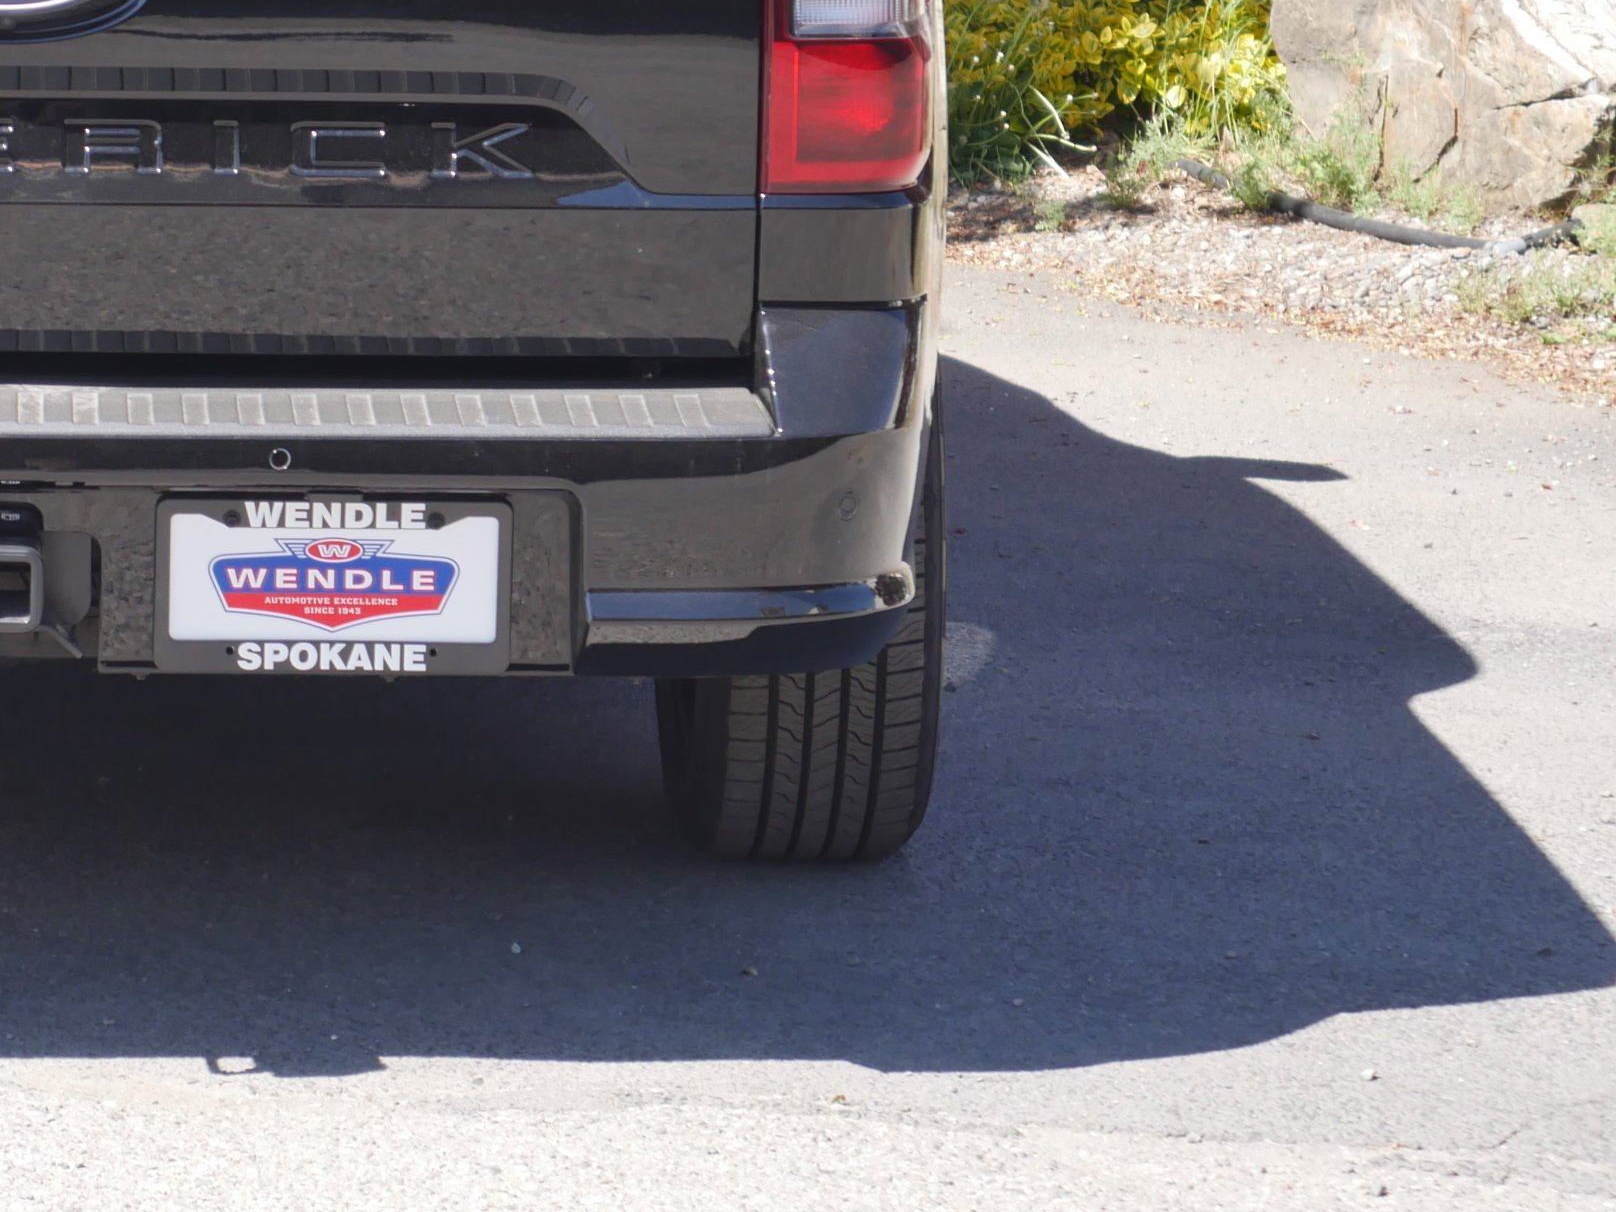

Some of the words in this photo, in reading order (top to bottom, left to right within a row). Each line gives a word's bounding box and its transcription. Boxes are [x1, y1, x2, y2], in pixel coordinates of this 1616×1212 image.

[245, 501, 427, 529] WENDLE
[227, 567, 435, 591] WENDLE
[264, 596, 331, 606] AUTOMOTIVE
[333, 597, 398, 606] EXCELLENCE
[303, 606, 335, 615] SINCE
[337, 606, 362, 615] 1943
[237, 642, 427, 672] SPOKANE
